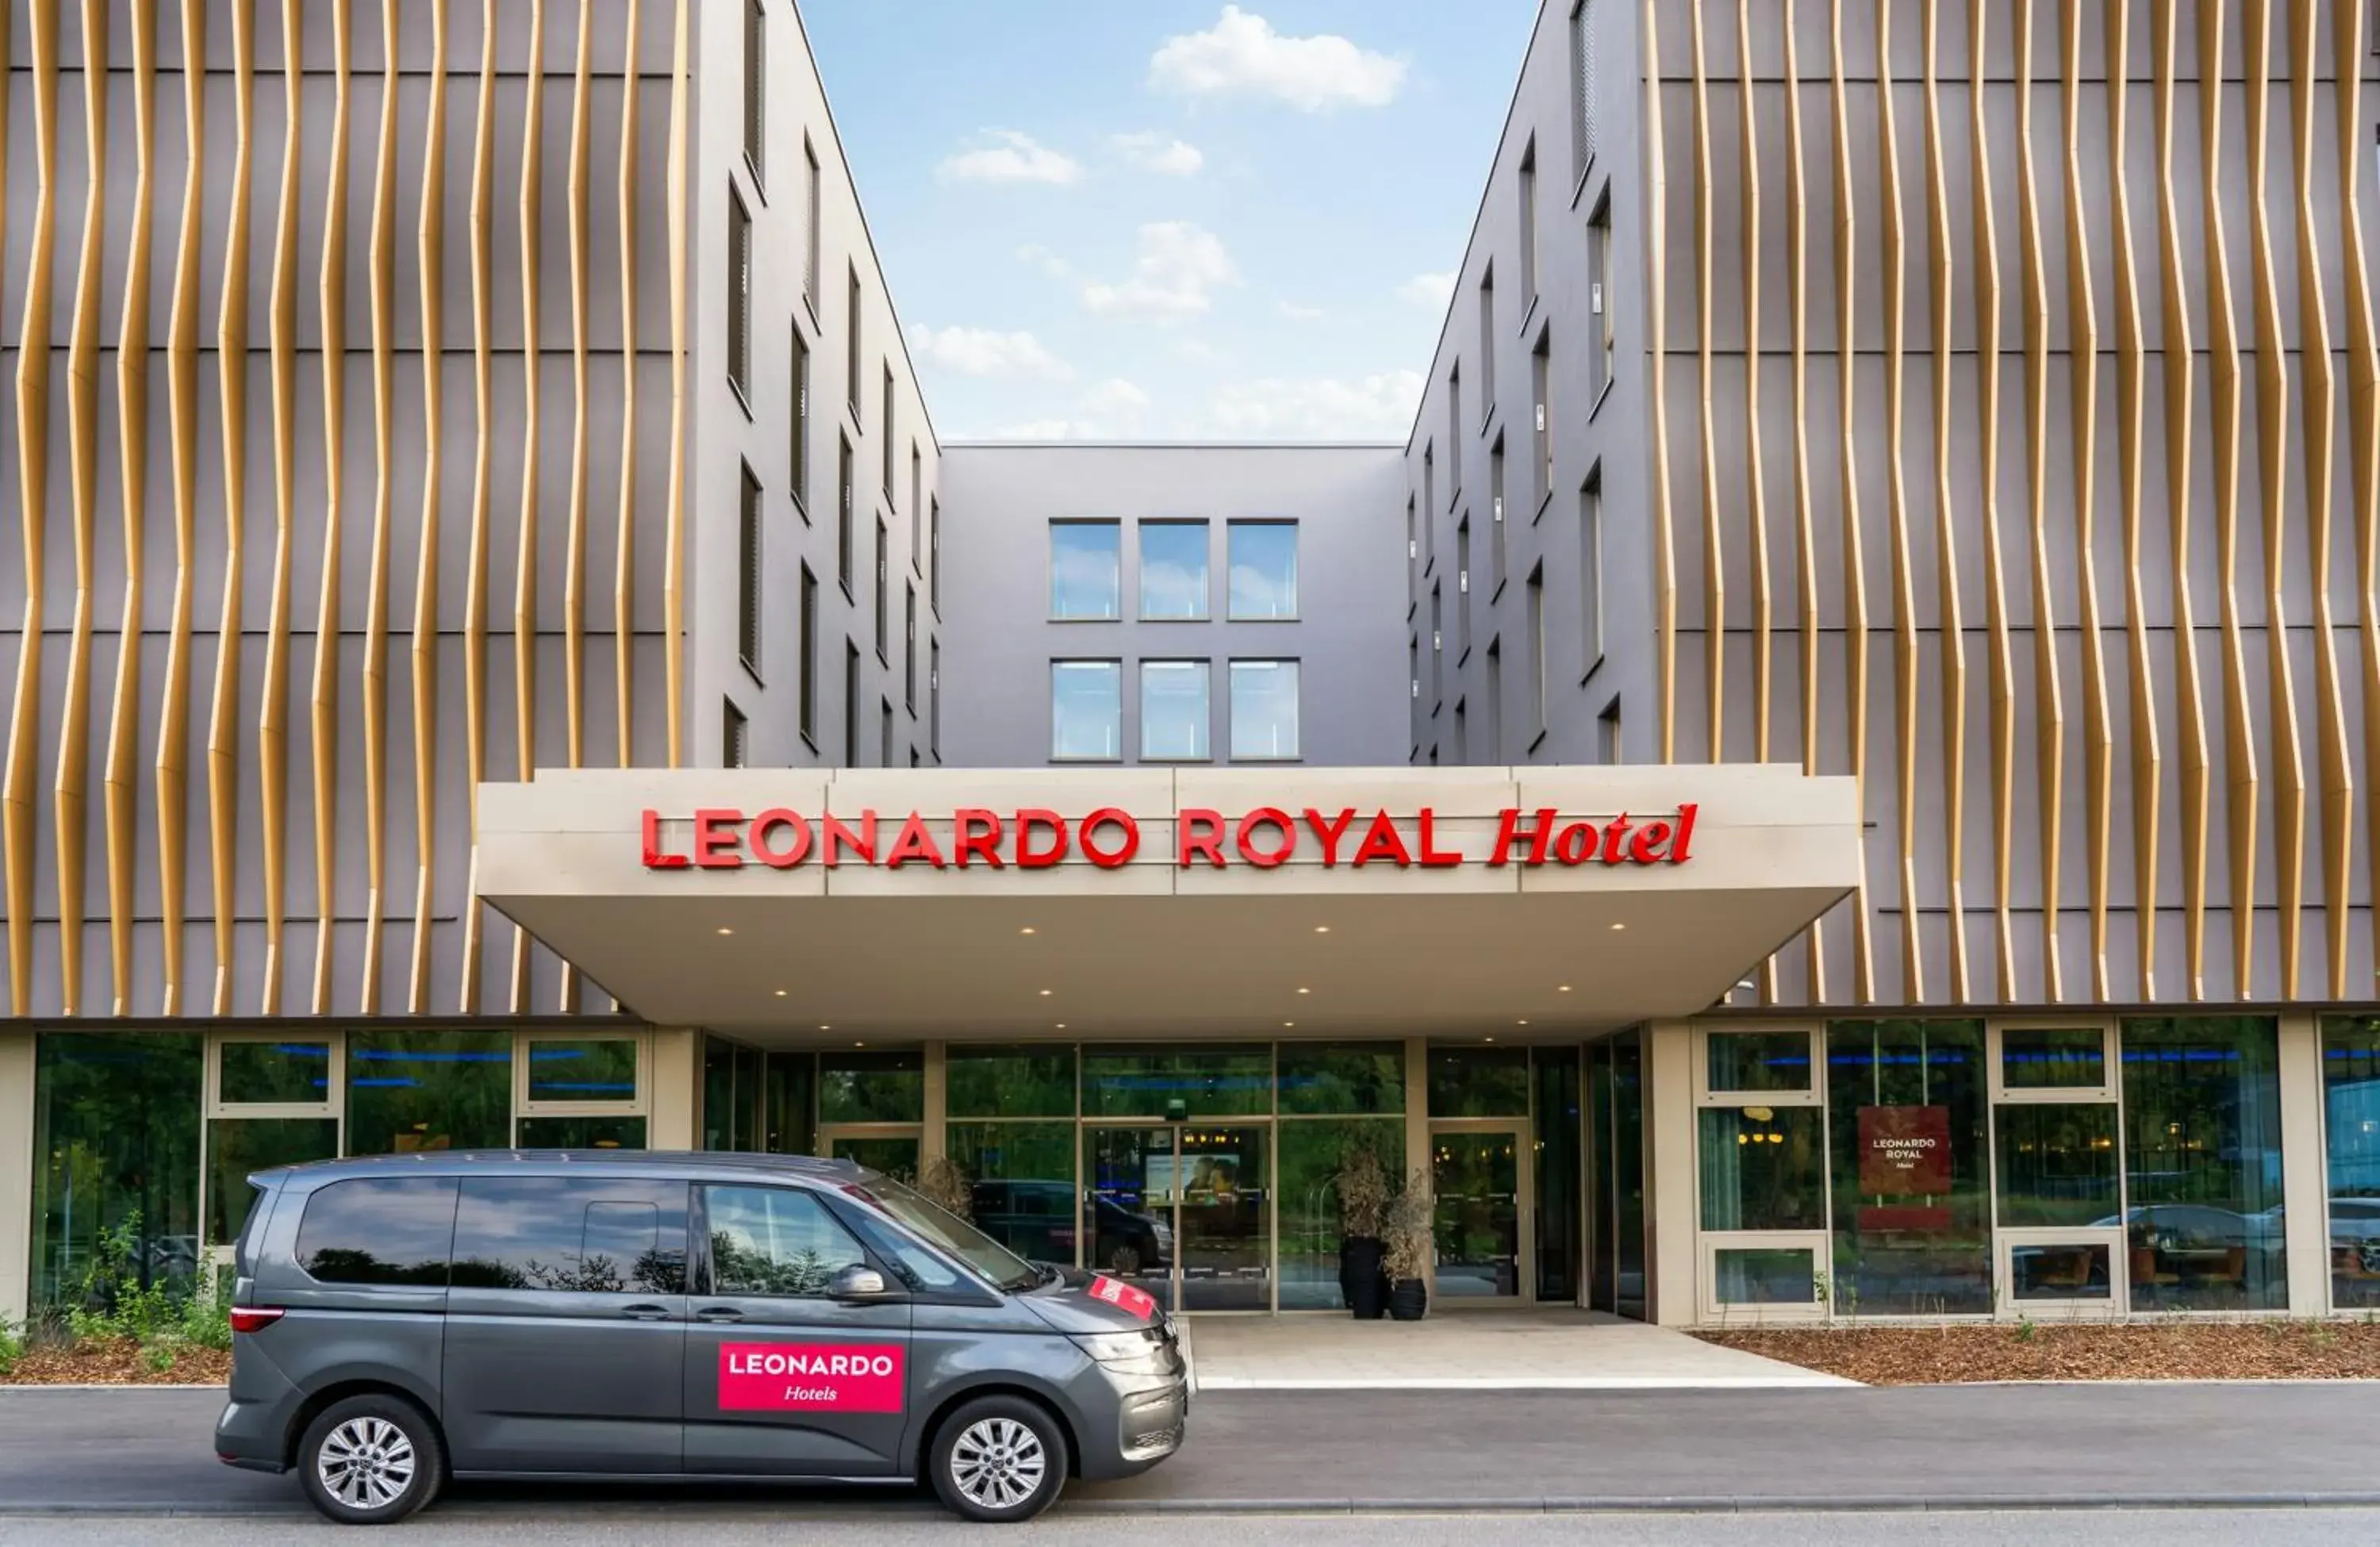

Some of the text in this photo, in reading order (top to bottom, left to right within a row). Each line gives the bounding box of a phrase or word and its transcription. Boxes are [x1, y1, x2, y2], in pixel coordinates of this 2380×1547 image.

[641, 803, 1699, 869] LEONARDO ROYAL Hotel
[1873, 1139, 1936, 1148] LEONARDO
[1886, 1150, 1923, 1159] ROYAL
[729, 1353, 892, 1376] LEONARDO
[785, 1386, 837, 1401] Hotels
